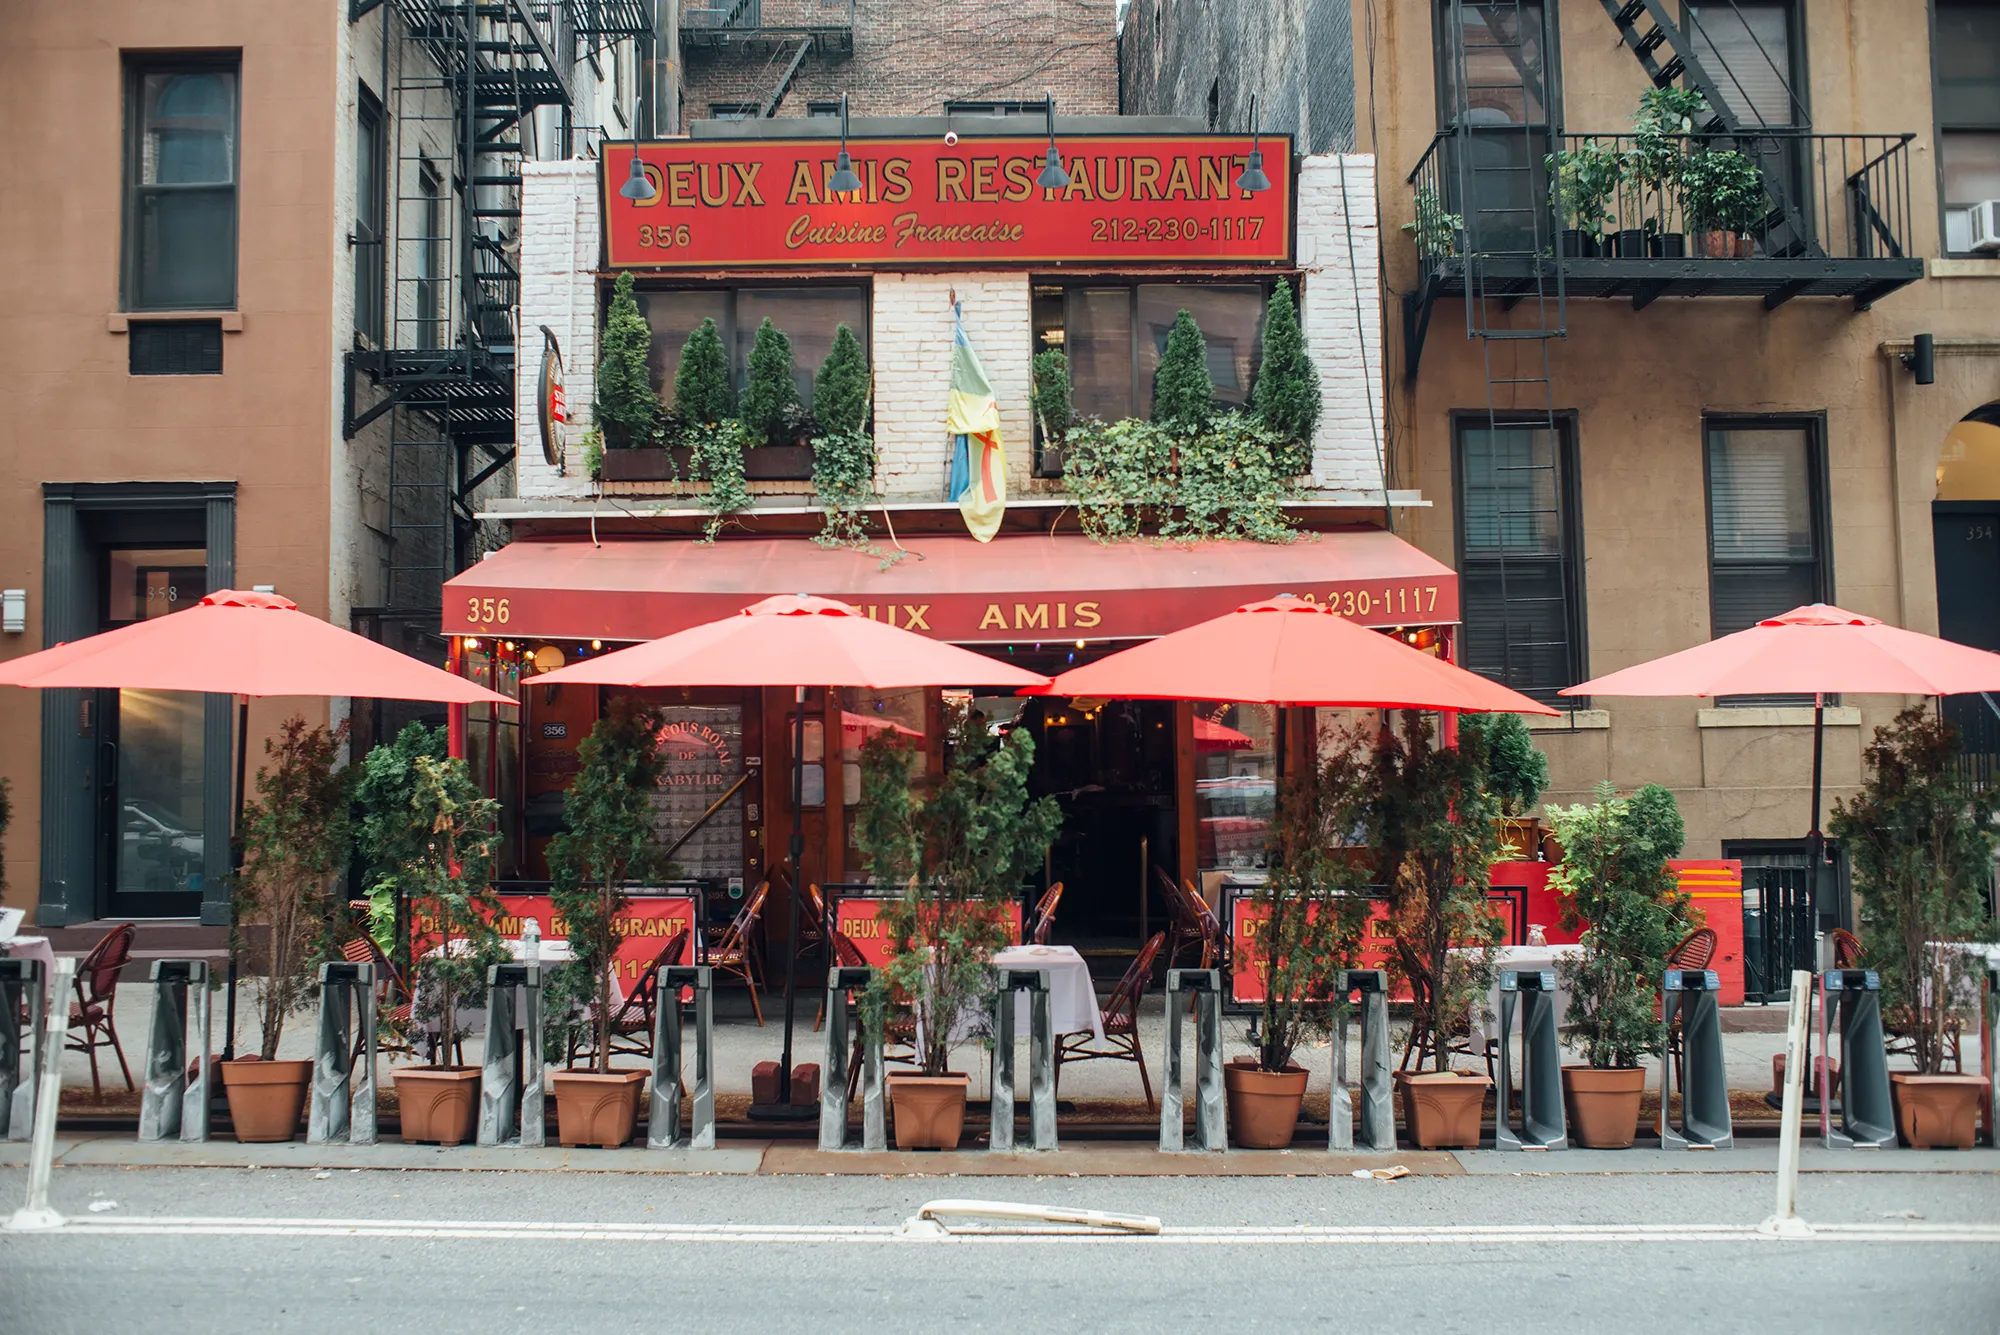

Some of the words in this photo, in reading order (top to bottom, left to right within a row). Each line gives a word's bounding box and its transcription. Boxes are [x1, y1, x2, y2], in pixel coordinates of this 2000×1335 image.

[632, 160, 766, 208] DEUX
[785, 158, 913, 205] AMIS
[638, 224, 691, 249] 356
[785, 214, 887, 250] Cuisine
[892, 211, 1025, 249] Francaise
[1091, 216, 1265, 243] 212-230-1117
[1966, 526, 1992, 541] 354
[147, 586, 177, 602] 358
[467, 597, 510, 624] 356
[978, 602, 1102, 631] AMIS
[544, 723, 566, 737] 356
[678, 751, 697, 761] DE
[701, 725, 732, 767] ROYAL
[843, 918, 880, 939] DEUX
